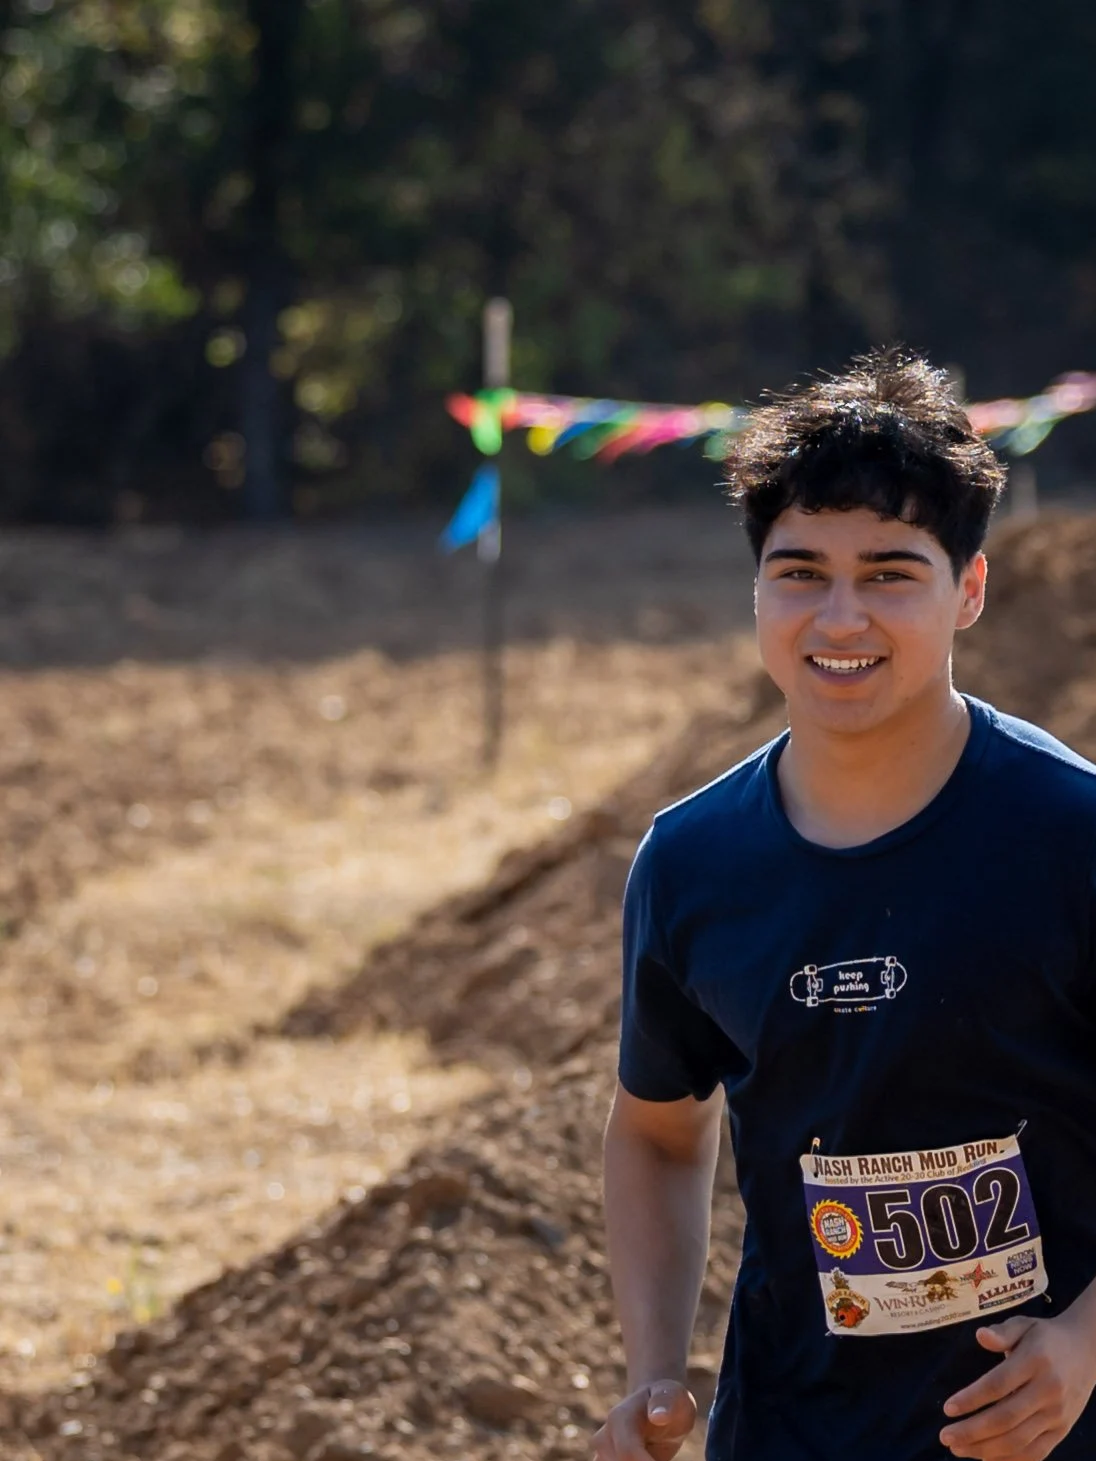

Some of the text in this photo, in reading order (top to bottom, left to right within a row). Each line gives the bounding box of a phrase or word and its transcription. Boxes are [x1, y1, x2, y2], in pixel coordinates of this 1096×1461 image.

[838, 970, 863, 981] keep
[833, 980, 869, 995] pushing
[814, 1142, 997, 1176] NASH RANCH MUD RUN
[825, 1175, 848, 1184] hosted
[850, 1175, 859, 1185] by
[860, 1174, 873, 1183] the
[874, 1173, 899, 1183] Active
[901, 1170, 925, 1181] 20-30
[927, 1168, 945, 1179] Club
[948, 1167, 956, 1176] of
[866, 1167, 1030, 1270] 502
